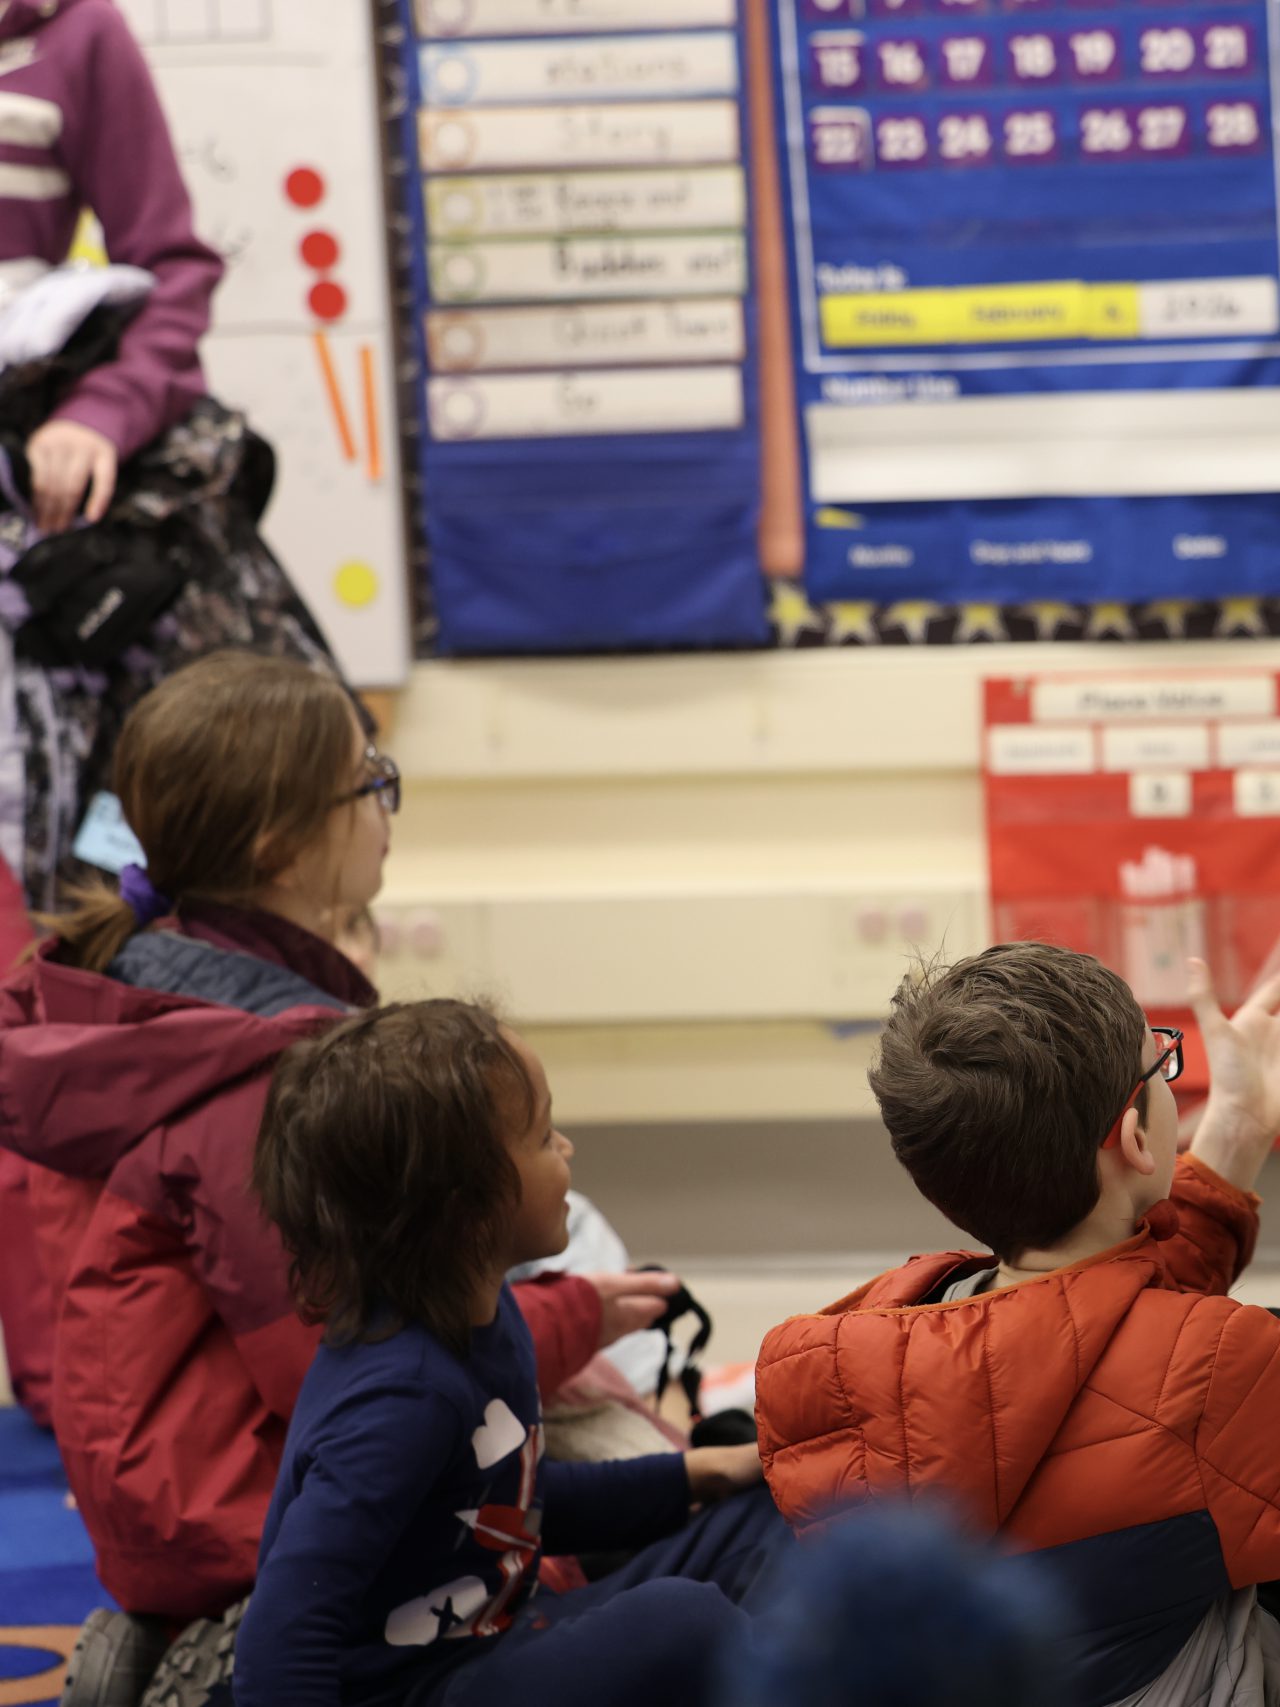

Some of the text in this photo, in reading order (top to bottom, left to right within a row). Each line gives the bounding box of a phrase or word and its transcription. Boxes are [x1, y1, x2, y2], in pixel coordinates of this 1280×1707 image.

[818, 27, 1247, 85] 15 16 17 18 19 20 21
[880, 119, 926, 160] 23
[939, 118, 990, 157] 24
[1006, 113, 1054, 155] 25
[1082, 110, 1130, 152] 26
[1139, 107, 1185, 149] 27
[1208, 105, 1257, 145] 28
